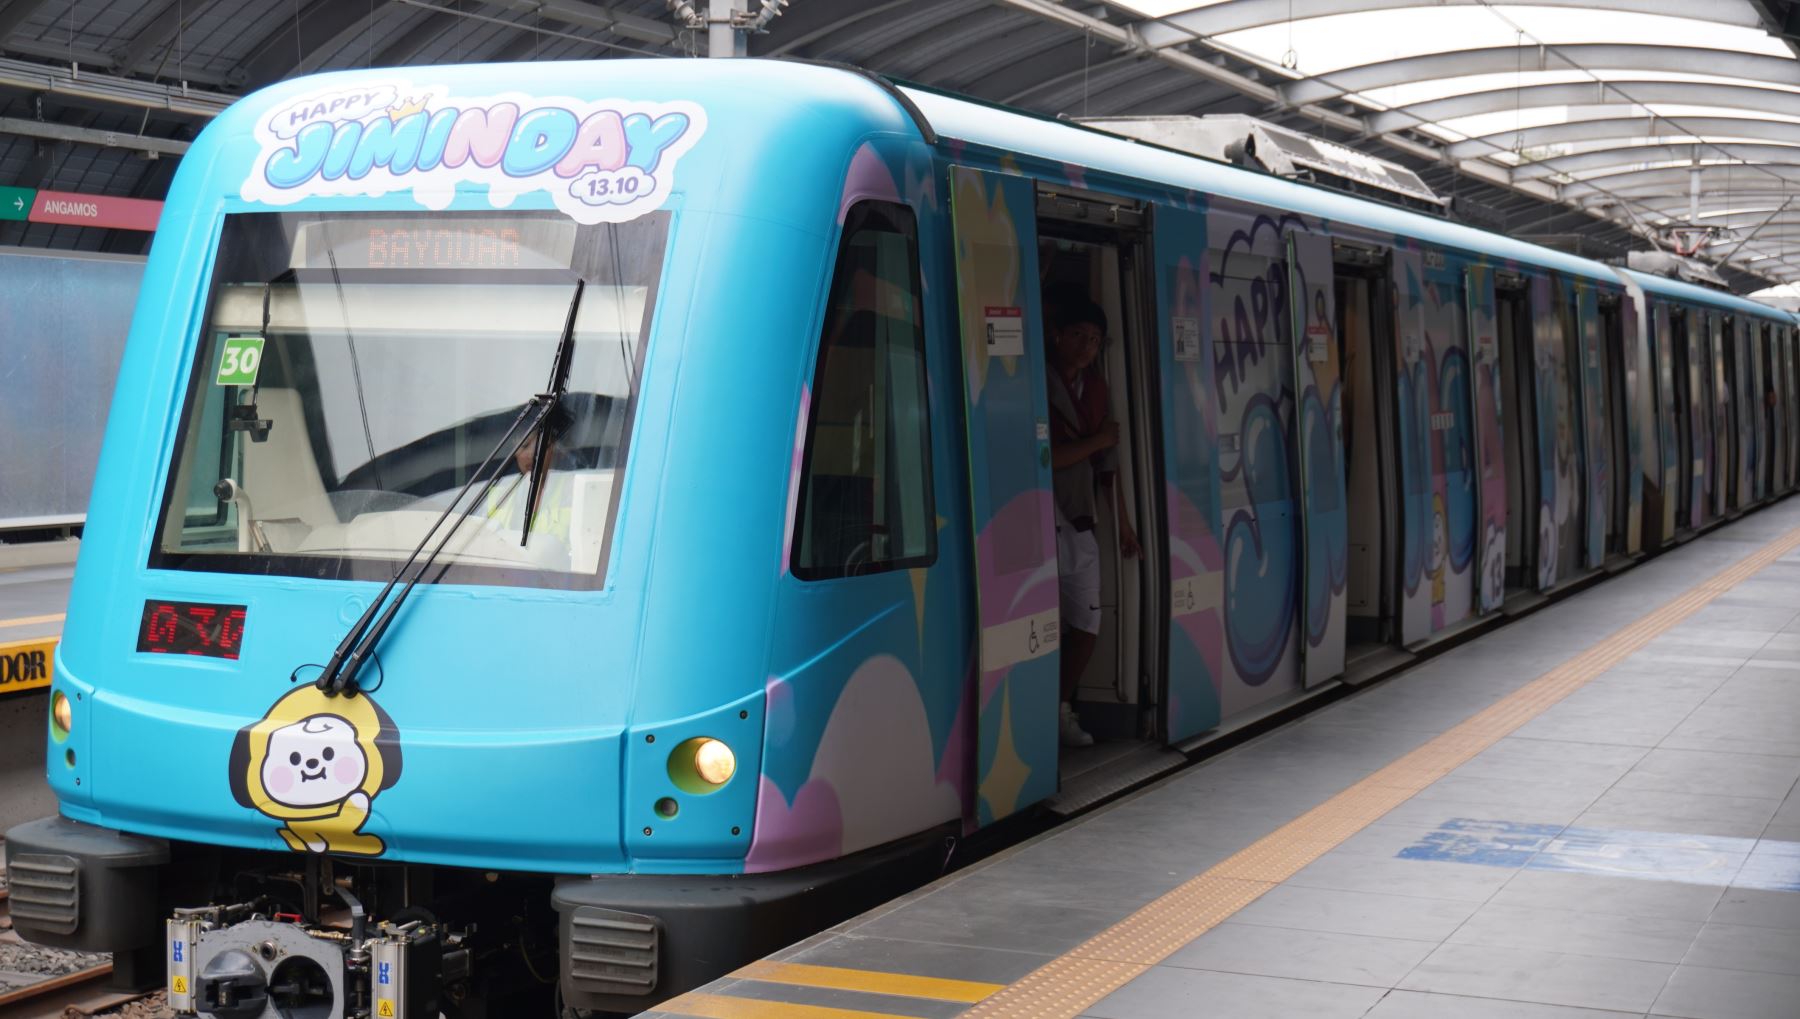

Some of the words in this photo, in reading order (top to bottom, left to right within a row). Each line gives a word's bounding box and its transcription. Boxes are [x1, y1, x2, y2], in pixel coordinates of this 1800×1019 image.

[290, 92, 380, 126] HAPPY
[588, 176, 639, 197] 13.10
[44, 200, 98, 218] ANGAMOS
[1213, 262, 1288, 414] HAPP
[220, 347, 259, 376] 30
